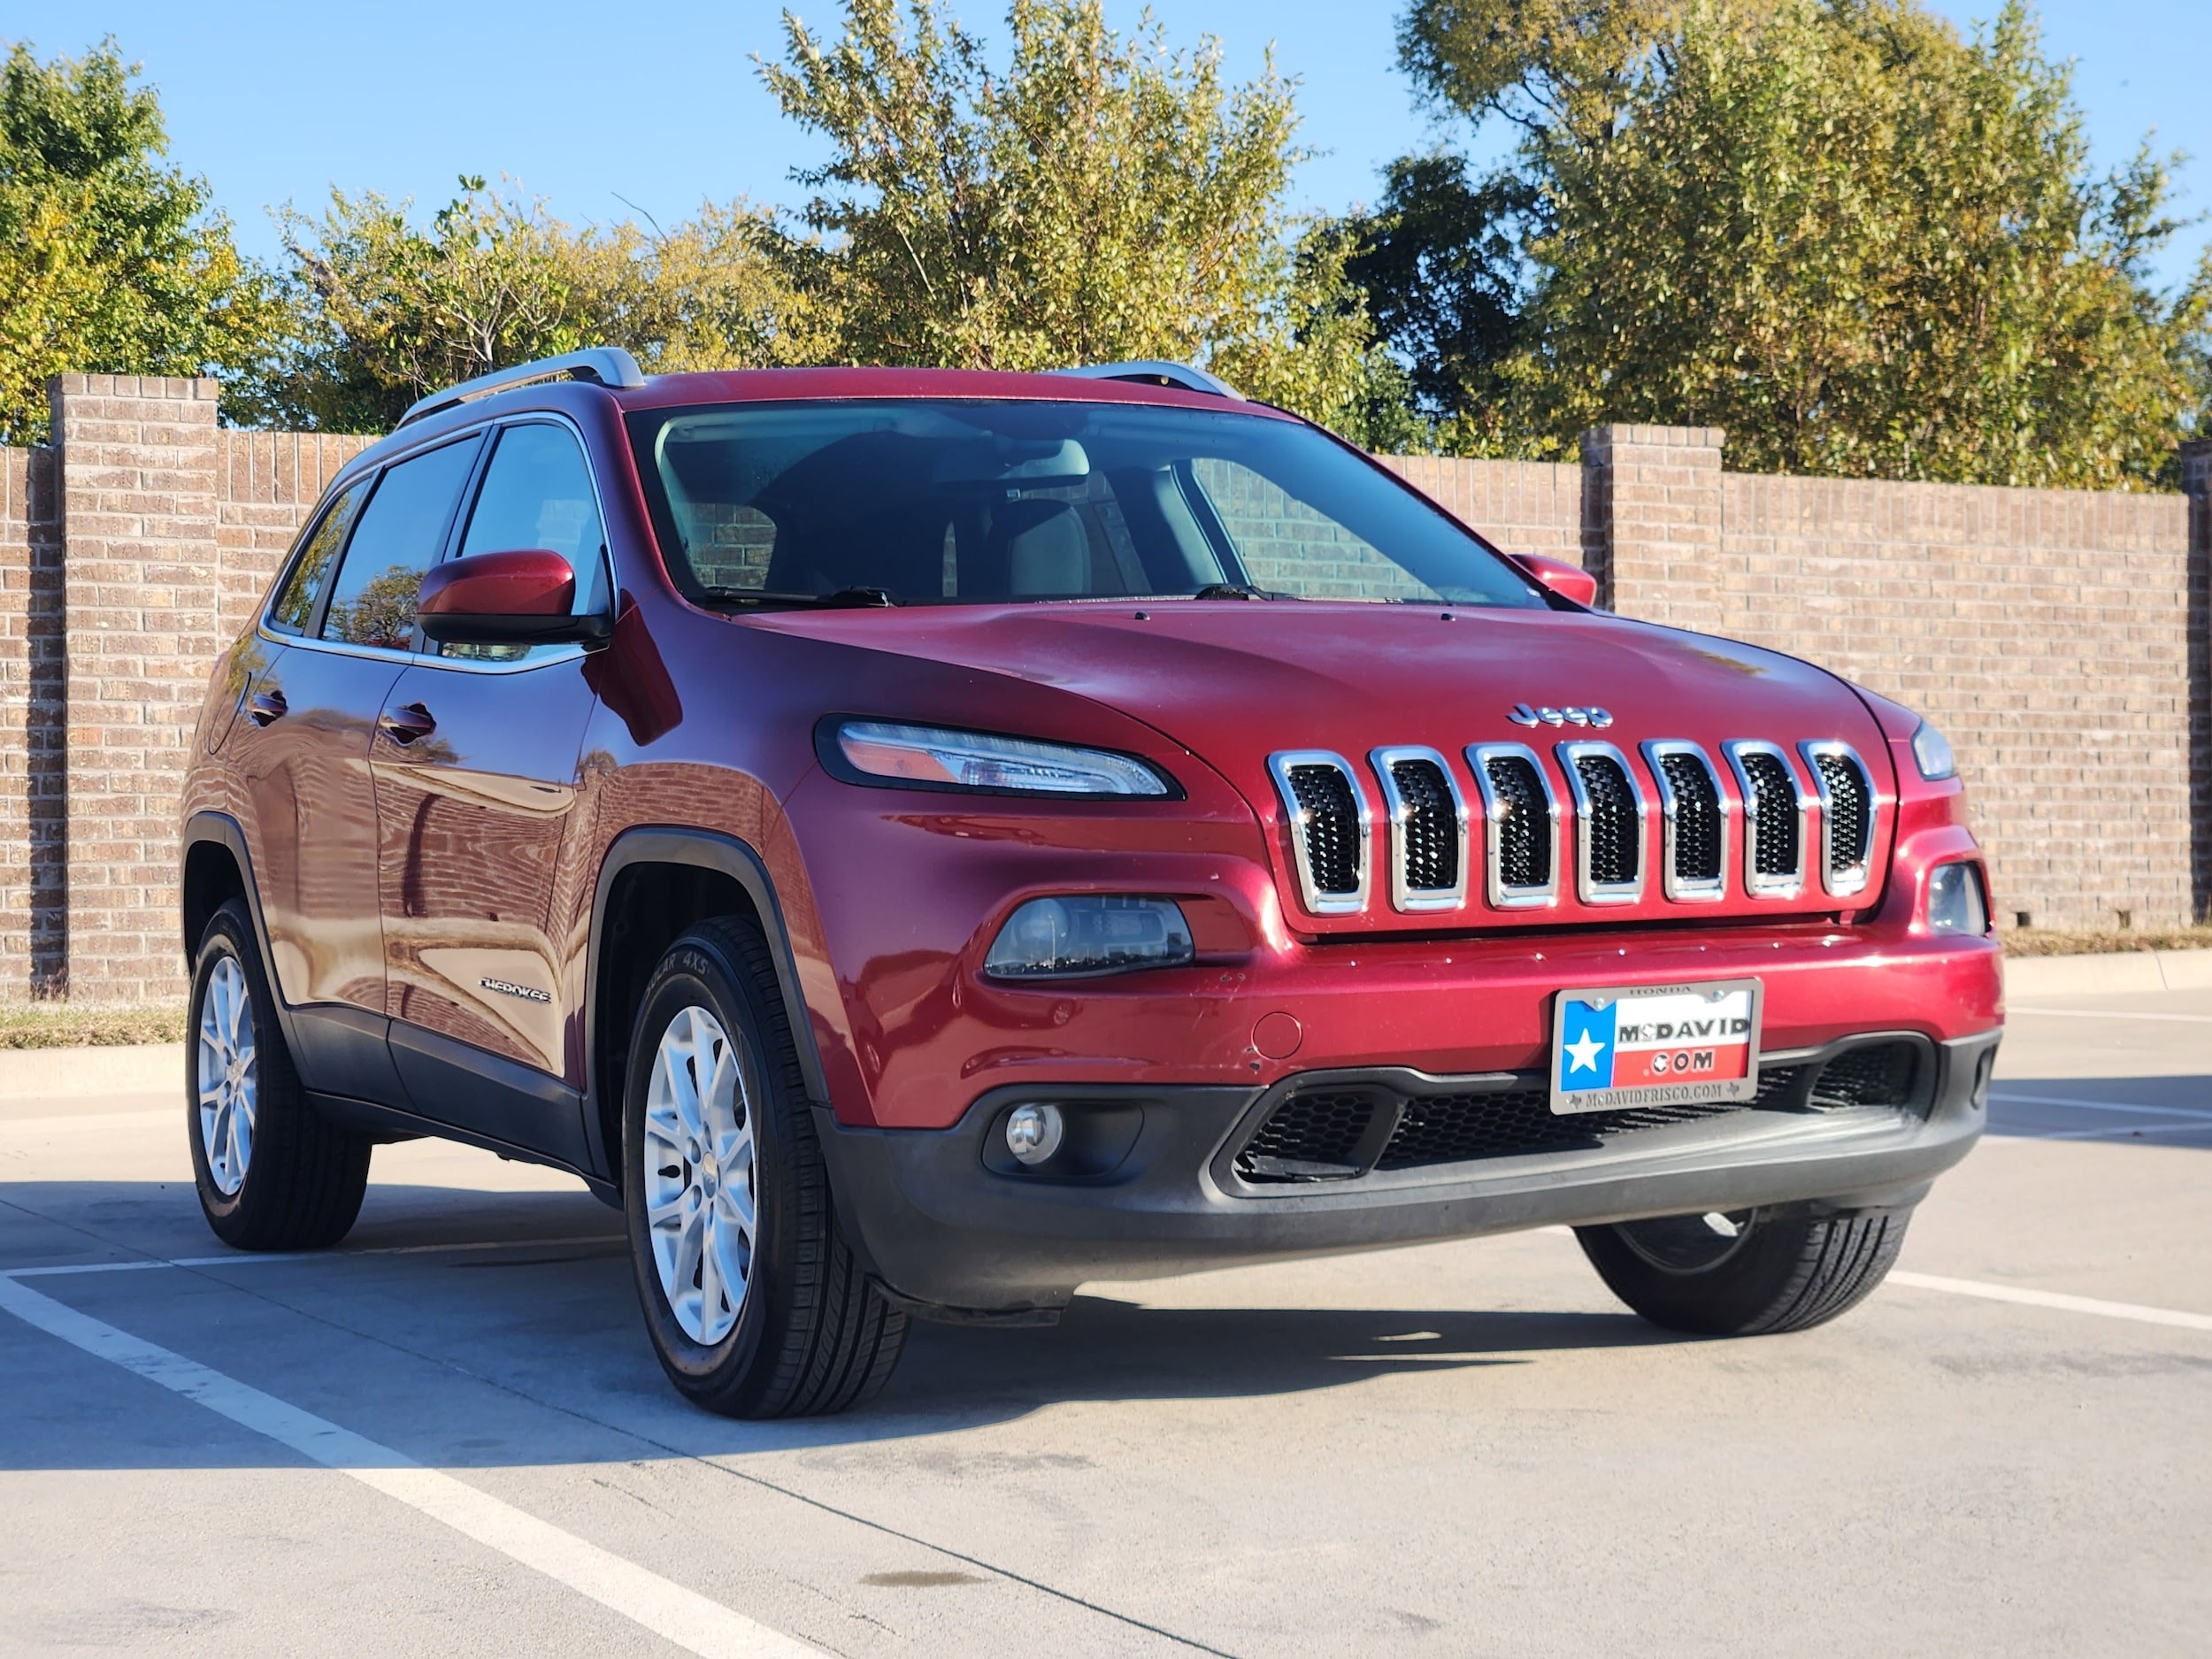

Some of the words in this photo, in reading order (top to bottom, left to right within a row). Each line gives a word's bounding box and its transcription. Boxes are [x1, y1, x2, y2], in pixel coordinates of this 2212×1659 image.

[1506, 703, 1614, 730] Jeep
[479, 977, 551, 1003] CHEROKEE
[1629, 986, 1691, 995] HONDA
